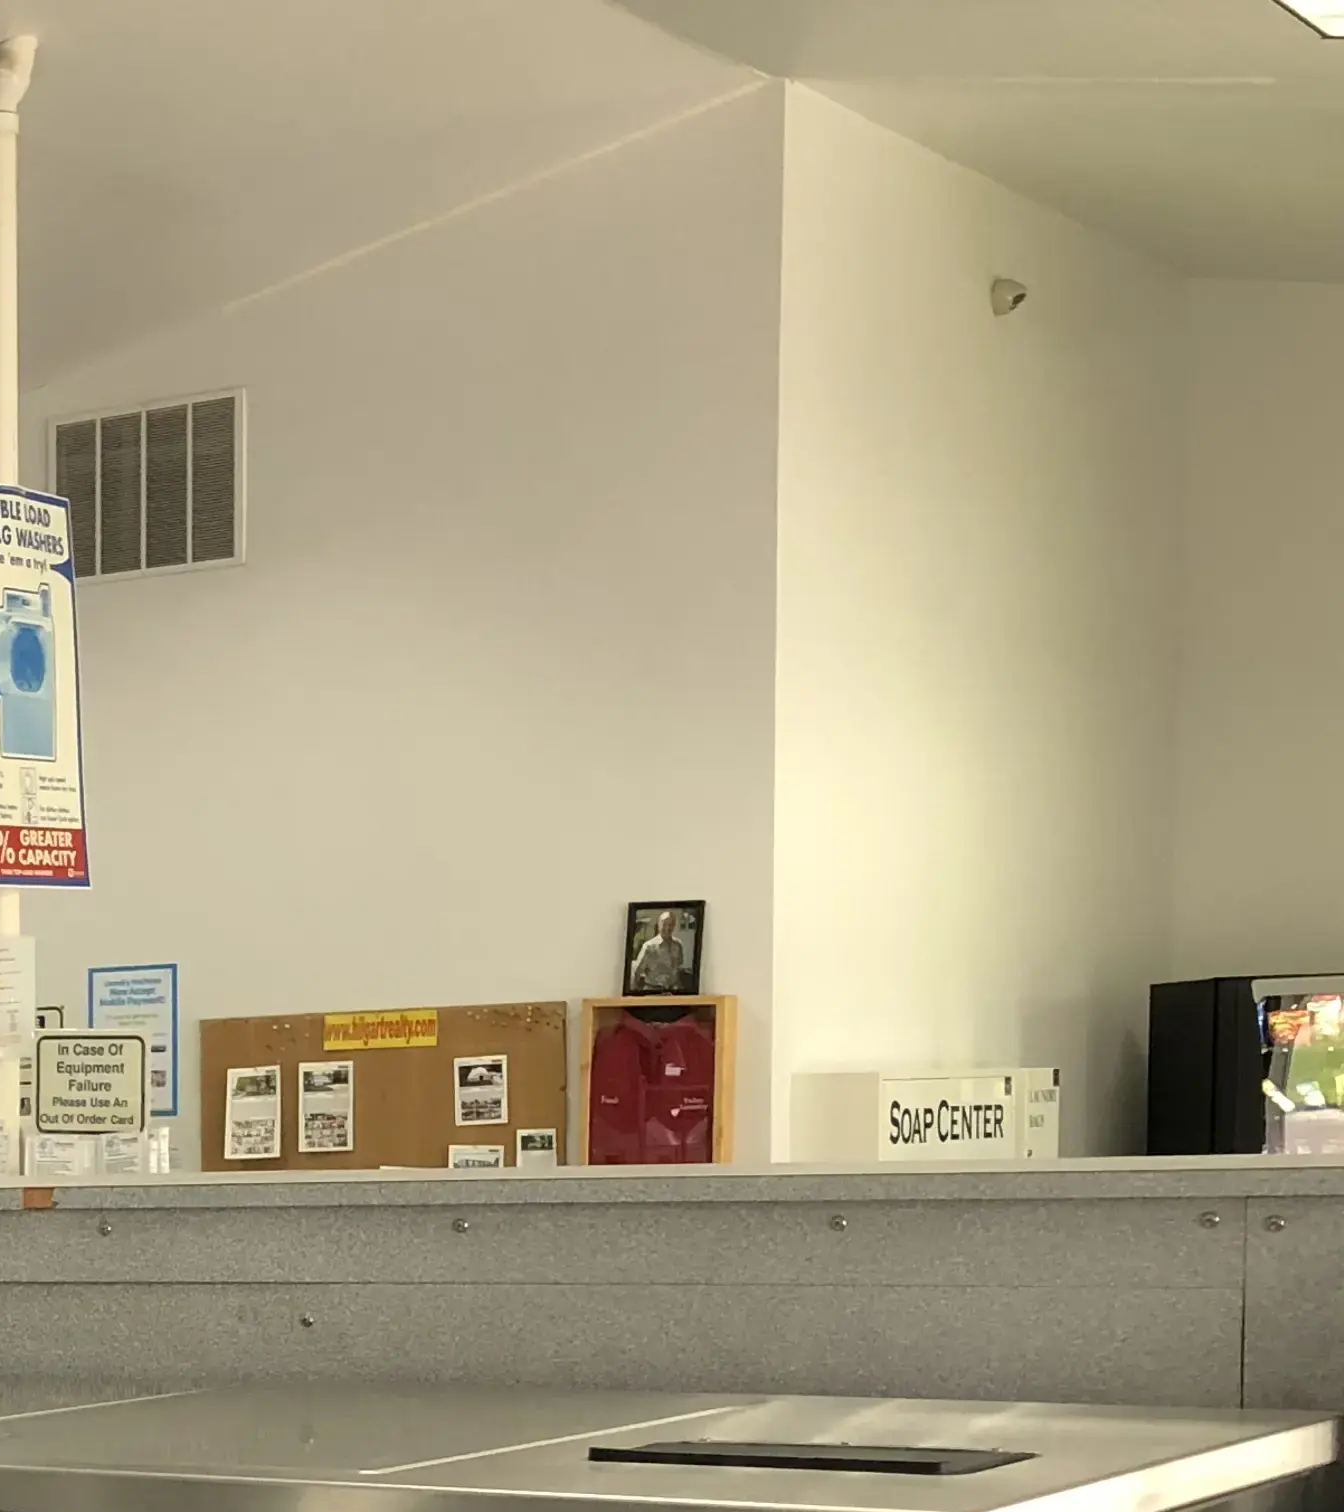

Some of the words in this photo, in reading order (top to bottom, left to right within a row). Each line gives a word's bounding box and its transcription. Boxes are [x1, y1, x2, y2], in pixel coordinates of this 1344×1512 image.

[24, 504, 50, 527] LOAD
[16, 528, 64, 556] WASHERS
[26, 559, 31, 568] a
[20, 830, 72, 848] GREATER
[19, 849, 76, 866] CAPACITY
[58, 1044, 69, 1055] In
[73, 1044, 104, 1056] Case
[108, 1044, 123, 1056] Of
[57, 1061, 124, 1076] Equipment
[68, 1079, 112, 1091] Failure
[52, 1096, 86, 1107] Please
[91, 1098, 110, 1107] Use
[113, 1098, 128, 1107] An
[40, 1114, 58, 1124] Out
[62, 1114, 73, 1124] Of
[77, 1114, 106, 1124] Order
[111, 1115, 133, 1124] Card
